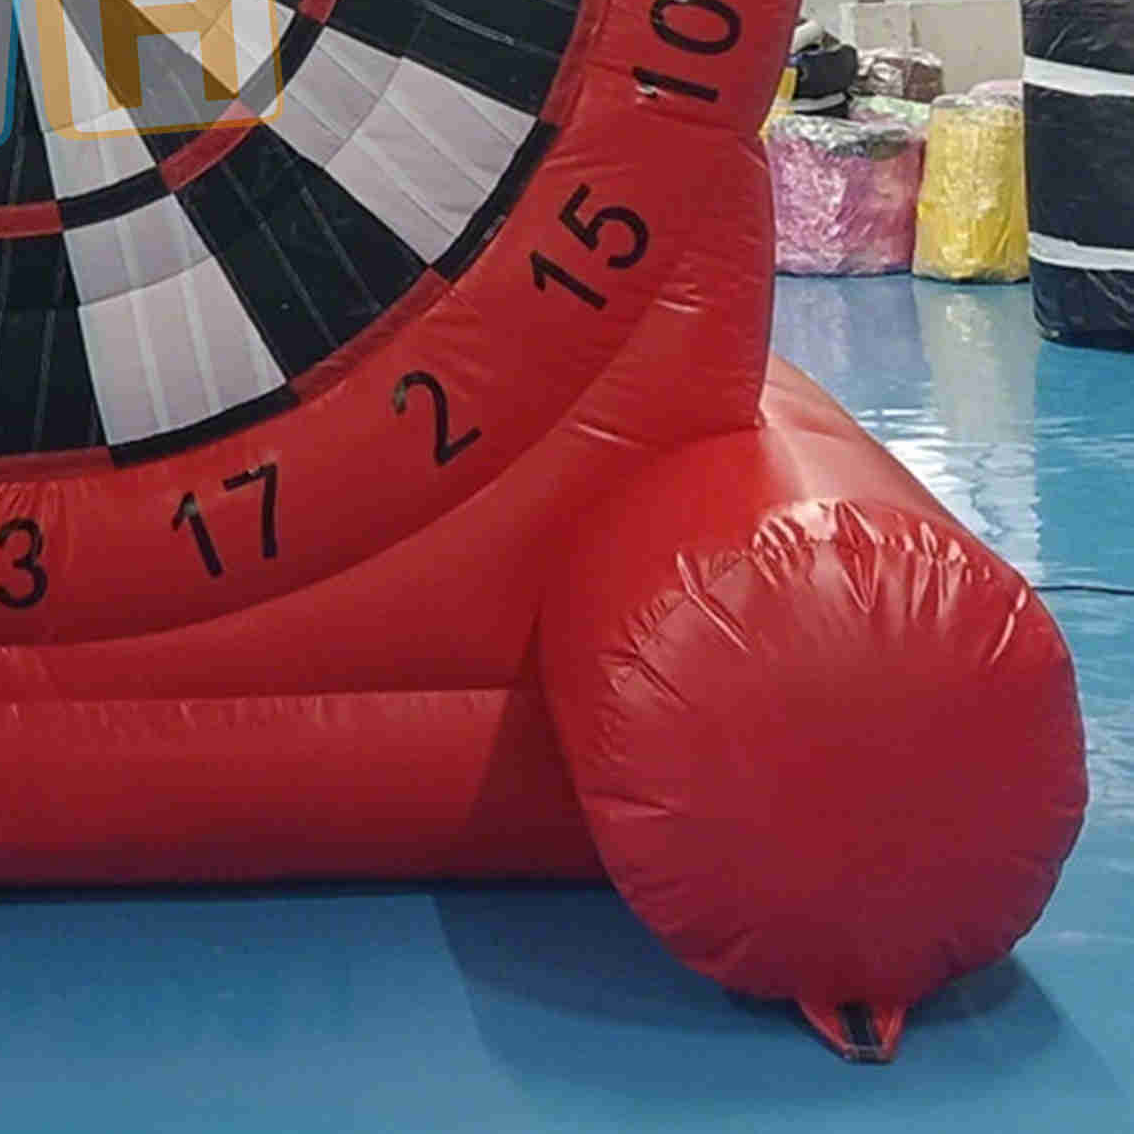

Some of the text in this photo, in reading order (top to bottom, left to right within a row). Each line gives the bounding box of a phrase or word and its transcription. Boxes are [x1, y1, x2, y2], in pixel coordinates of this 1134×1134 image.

[531, 183, 649, 309] 15
[394, 371, 482, 466] 2
[171, 461, 278, 578] 17
